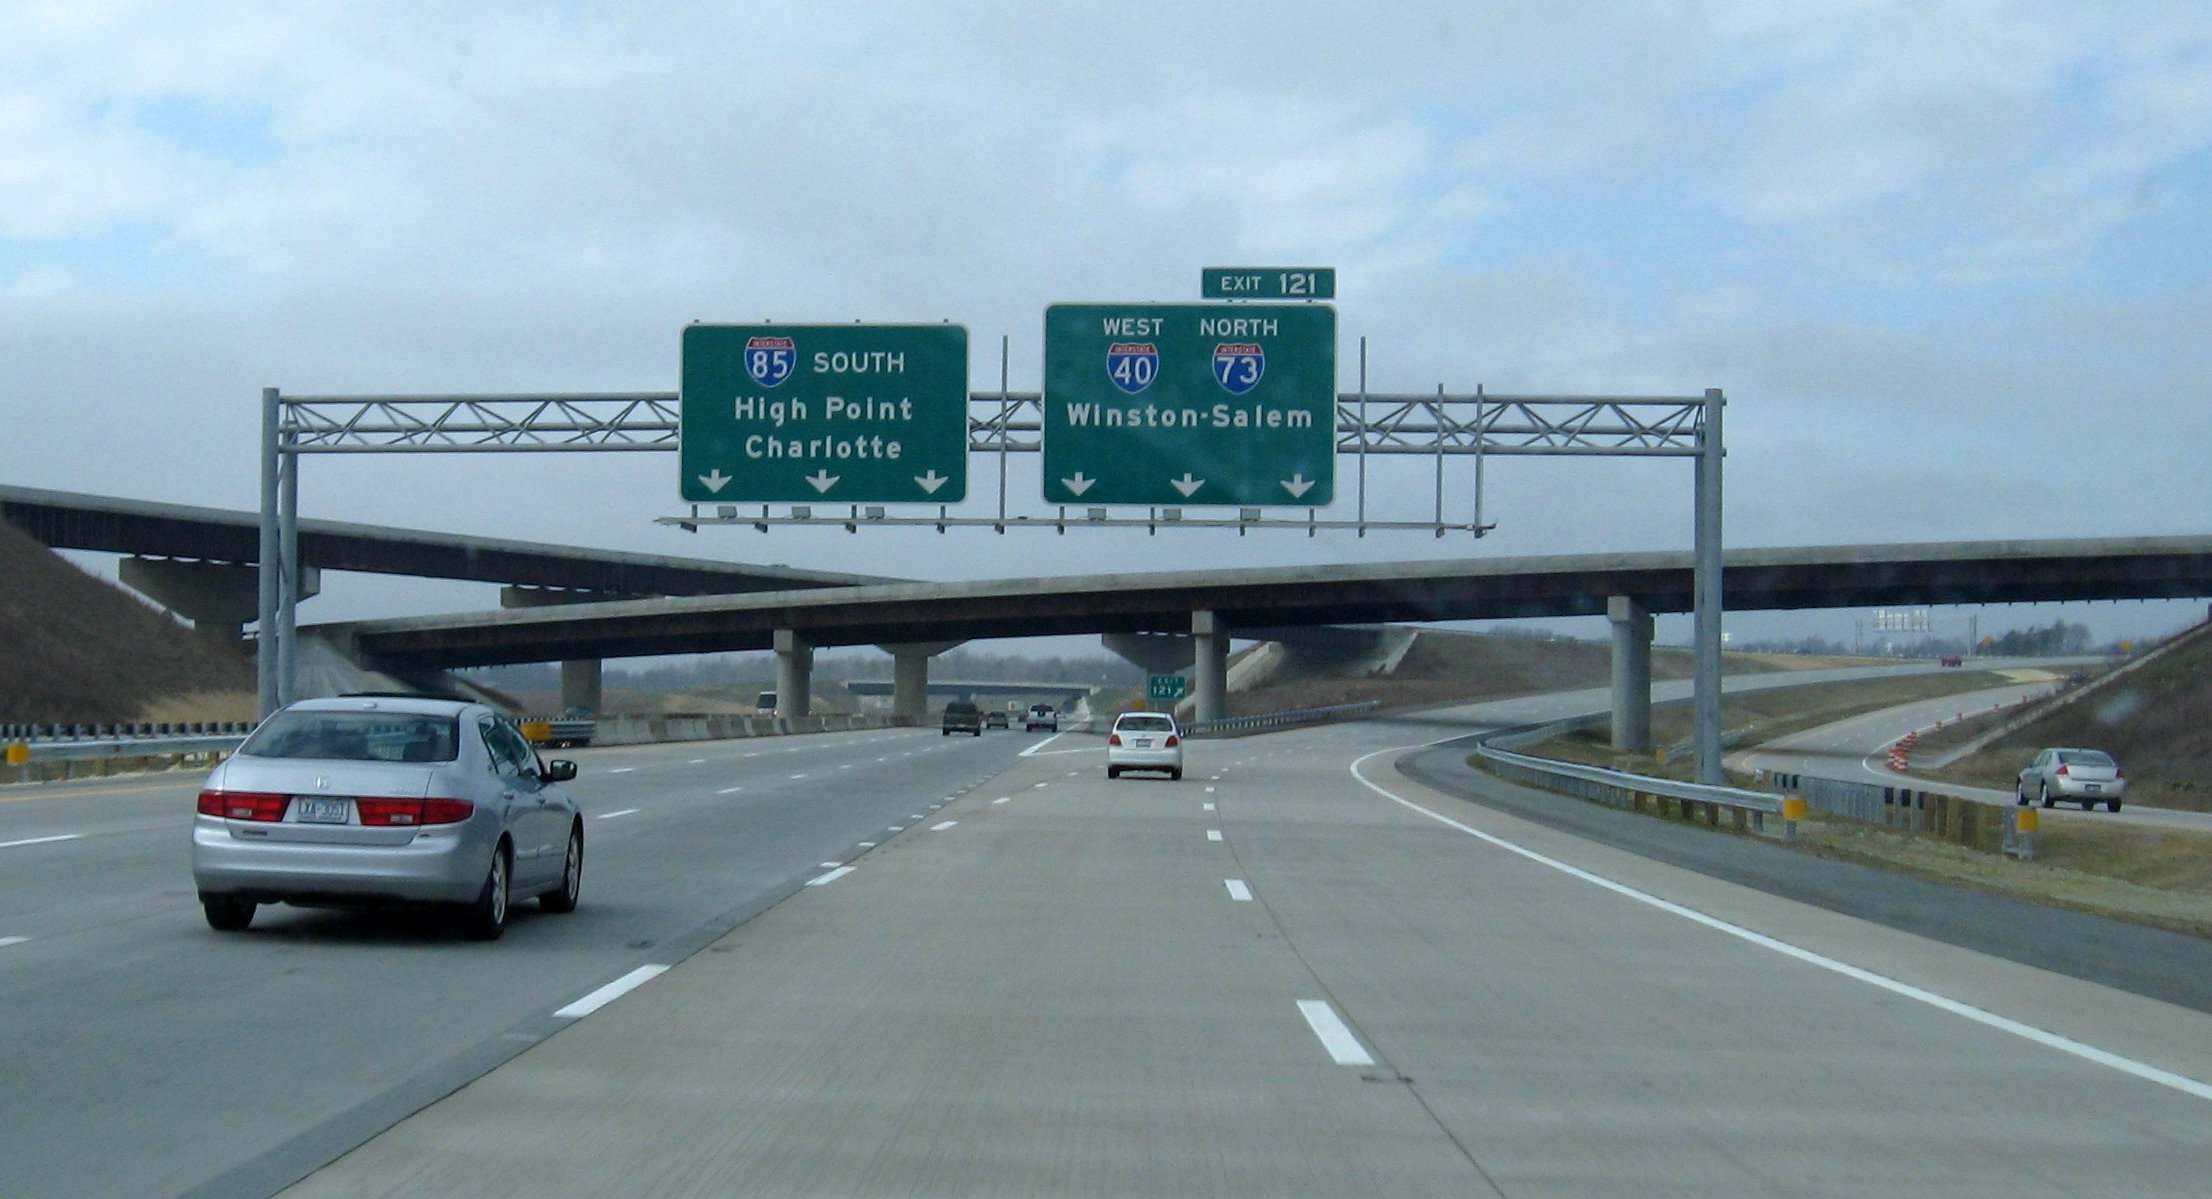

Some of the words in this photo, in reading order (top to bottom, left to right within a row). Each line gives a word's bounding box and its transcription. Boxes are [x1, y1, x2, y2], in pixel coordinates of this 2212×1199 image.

[1221, 276, 1262, 291] EXIT
[1279, 273, 1316, 294] 121
[1103, 318, 1164, 336] WEST
[1200, 318, 1278, 337] NORTH
[752, 350, 788, 378] 85
[813, 352, 905, 373] SOUTH
[1114, 356, 1151, 385] 40
[1216, 356, 1259, 384] 73
[734, 397, 807, 427] High
[826, 397, 912, 421] Point
[1067, 402, 1312, 428] Winston-Salem
[745, 435, 902, 459] Charlotte
[1153, 686, 1171, 695] 121
